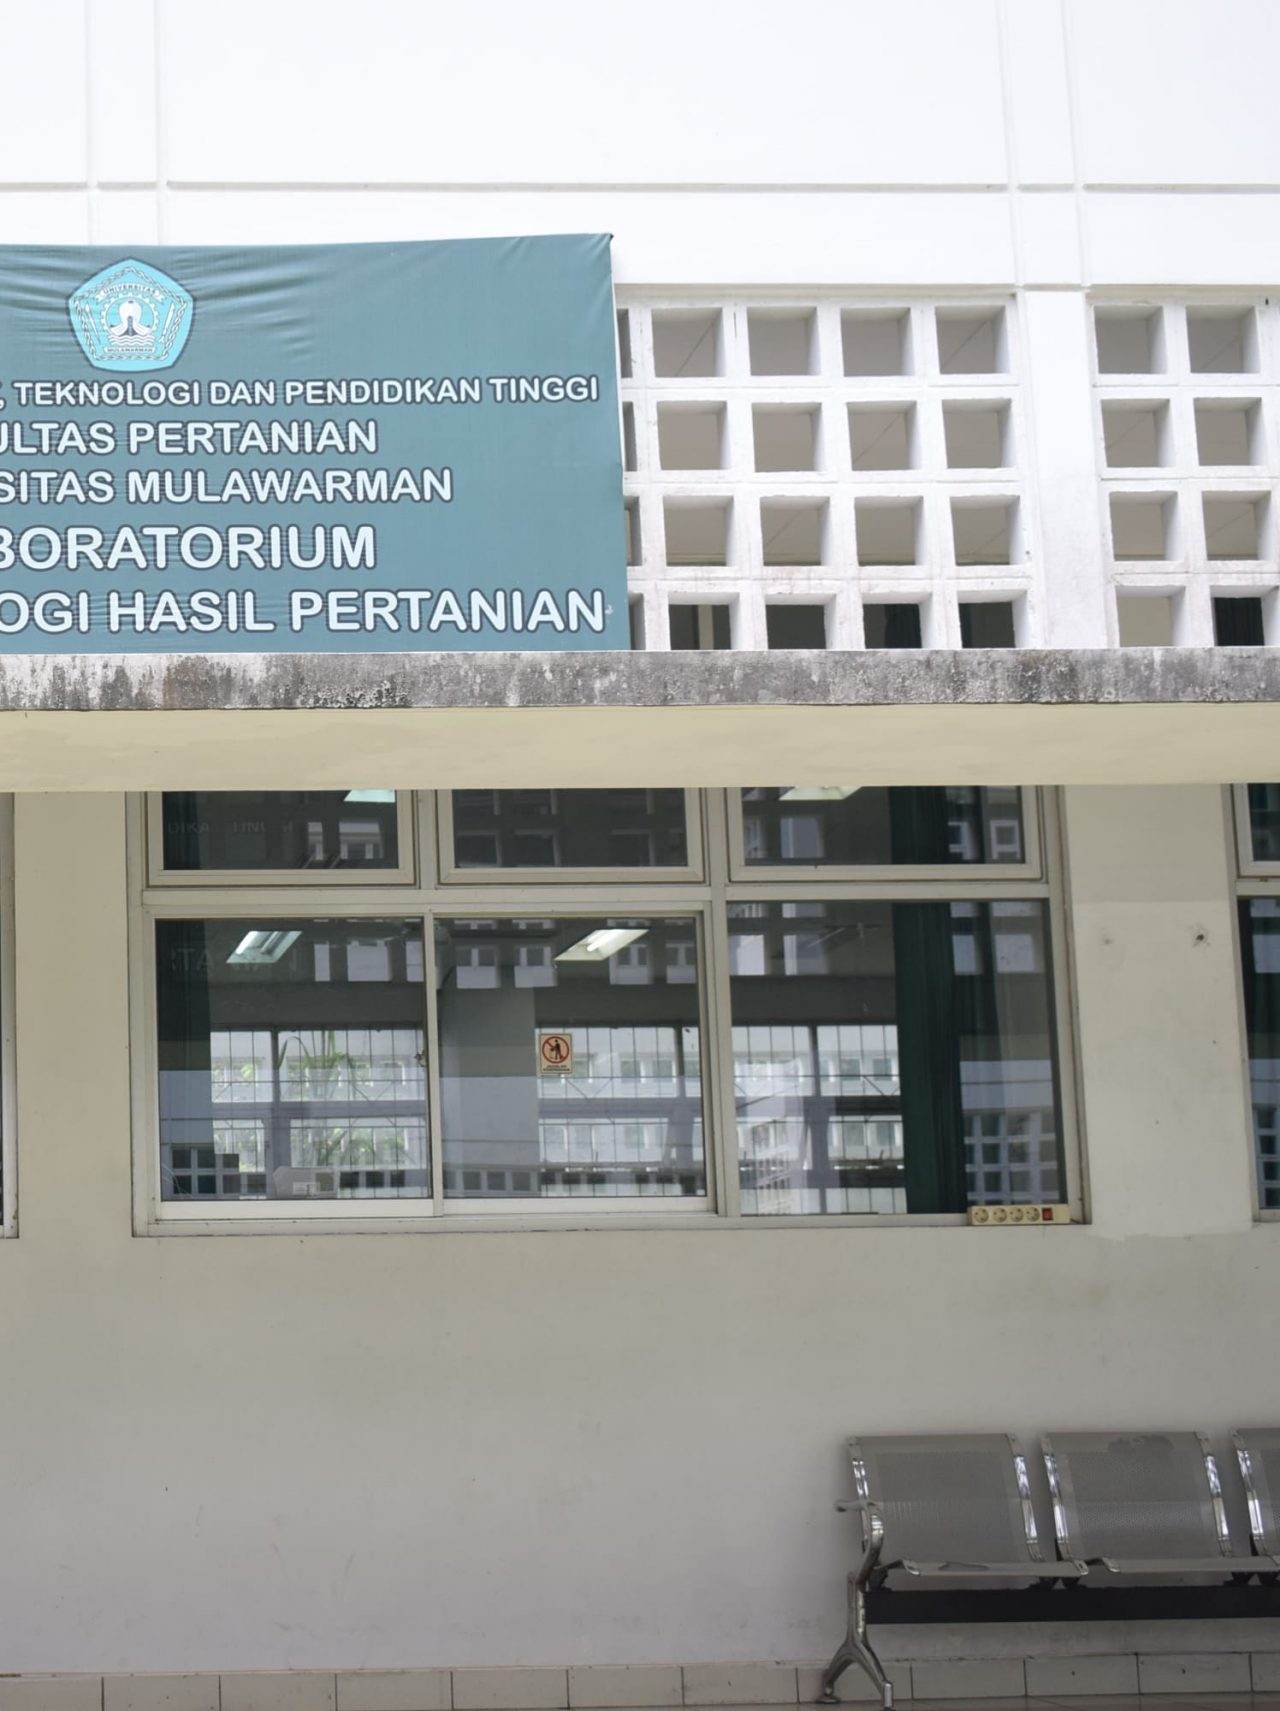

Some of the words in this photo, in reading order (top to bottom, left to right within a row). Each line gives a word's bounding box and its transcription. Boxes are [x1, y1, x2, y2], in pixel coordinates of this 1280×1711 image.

[13, 380, 200, 406] TEKNOLOGI
[210, 379, 275, 405] DAN
[285, 377, 480, 404] PENDIDIKAN
[489, 375, 599, 402] TINGGI
[127, 419, 378, 455] PERTANIAN
[126, 467, 453, 504] MULAWARMAN
[108, 589, 276, 634] HASIL
[289, 588, 605, 634] PERTANIAN
